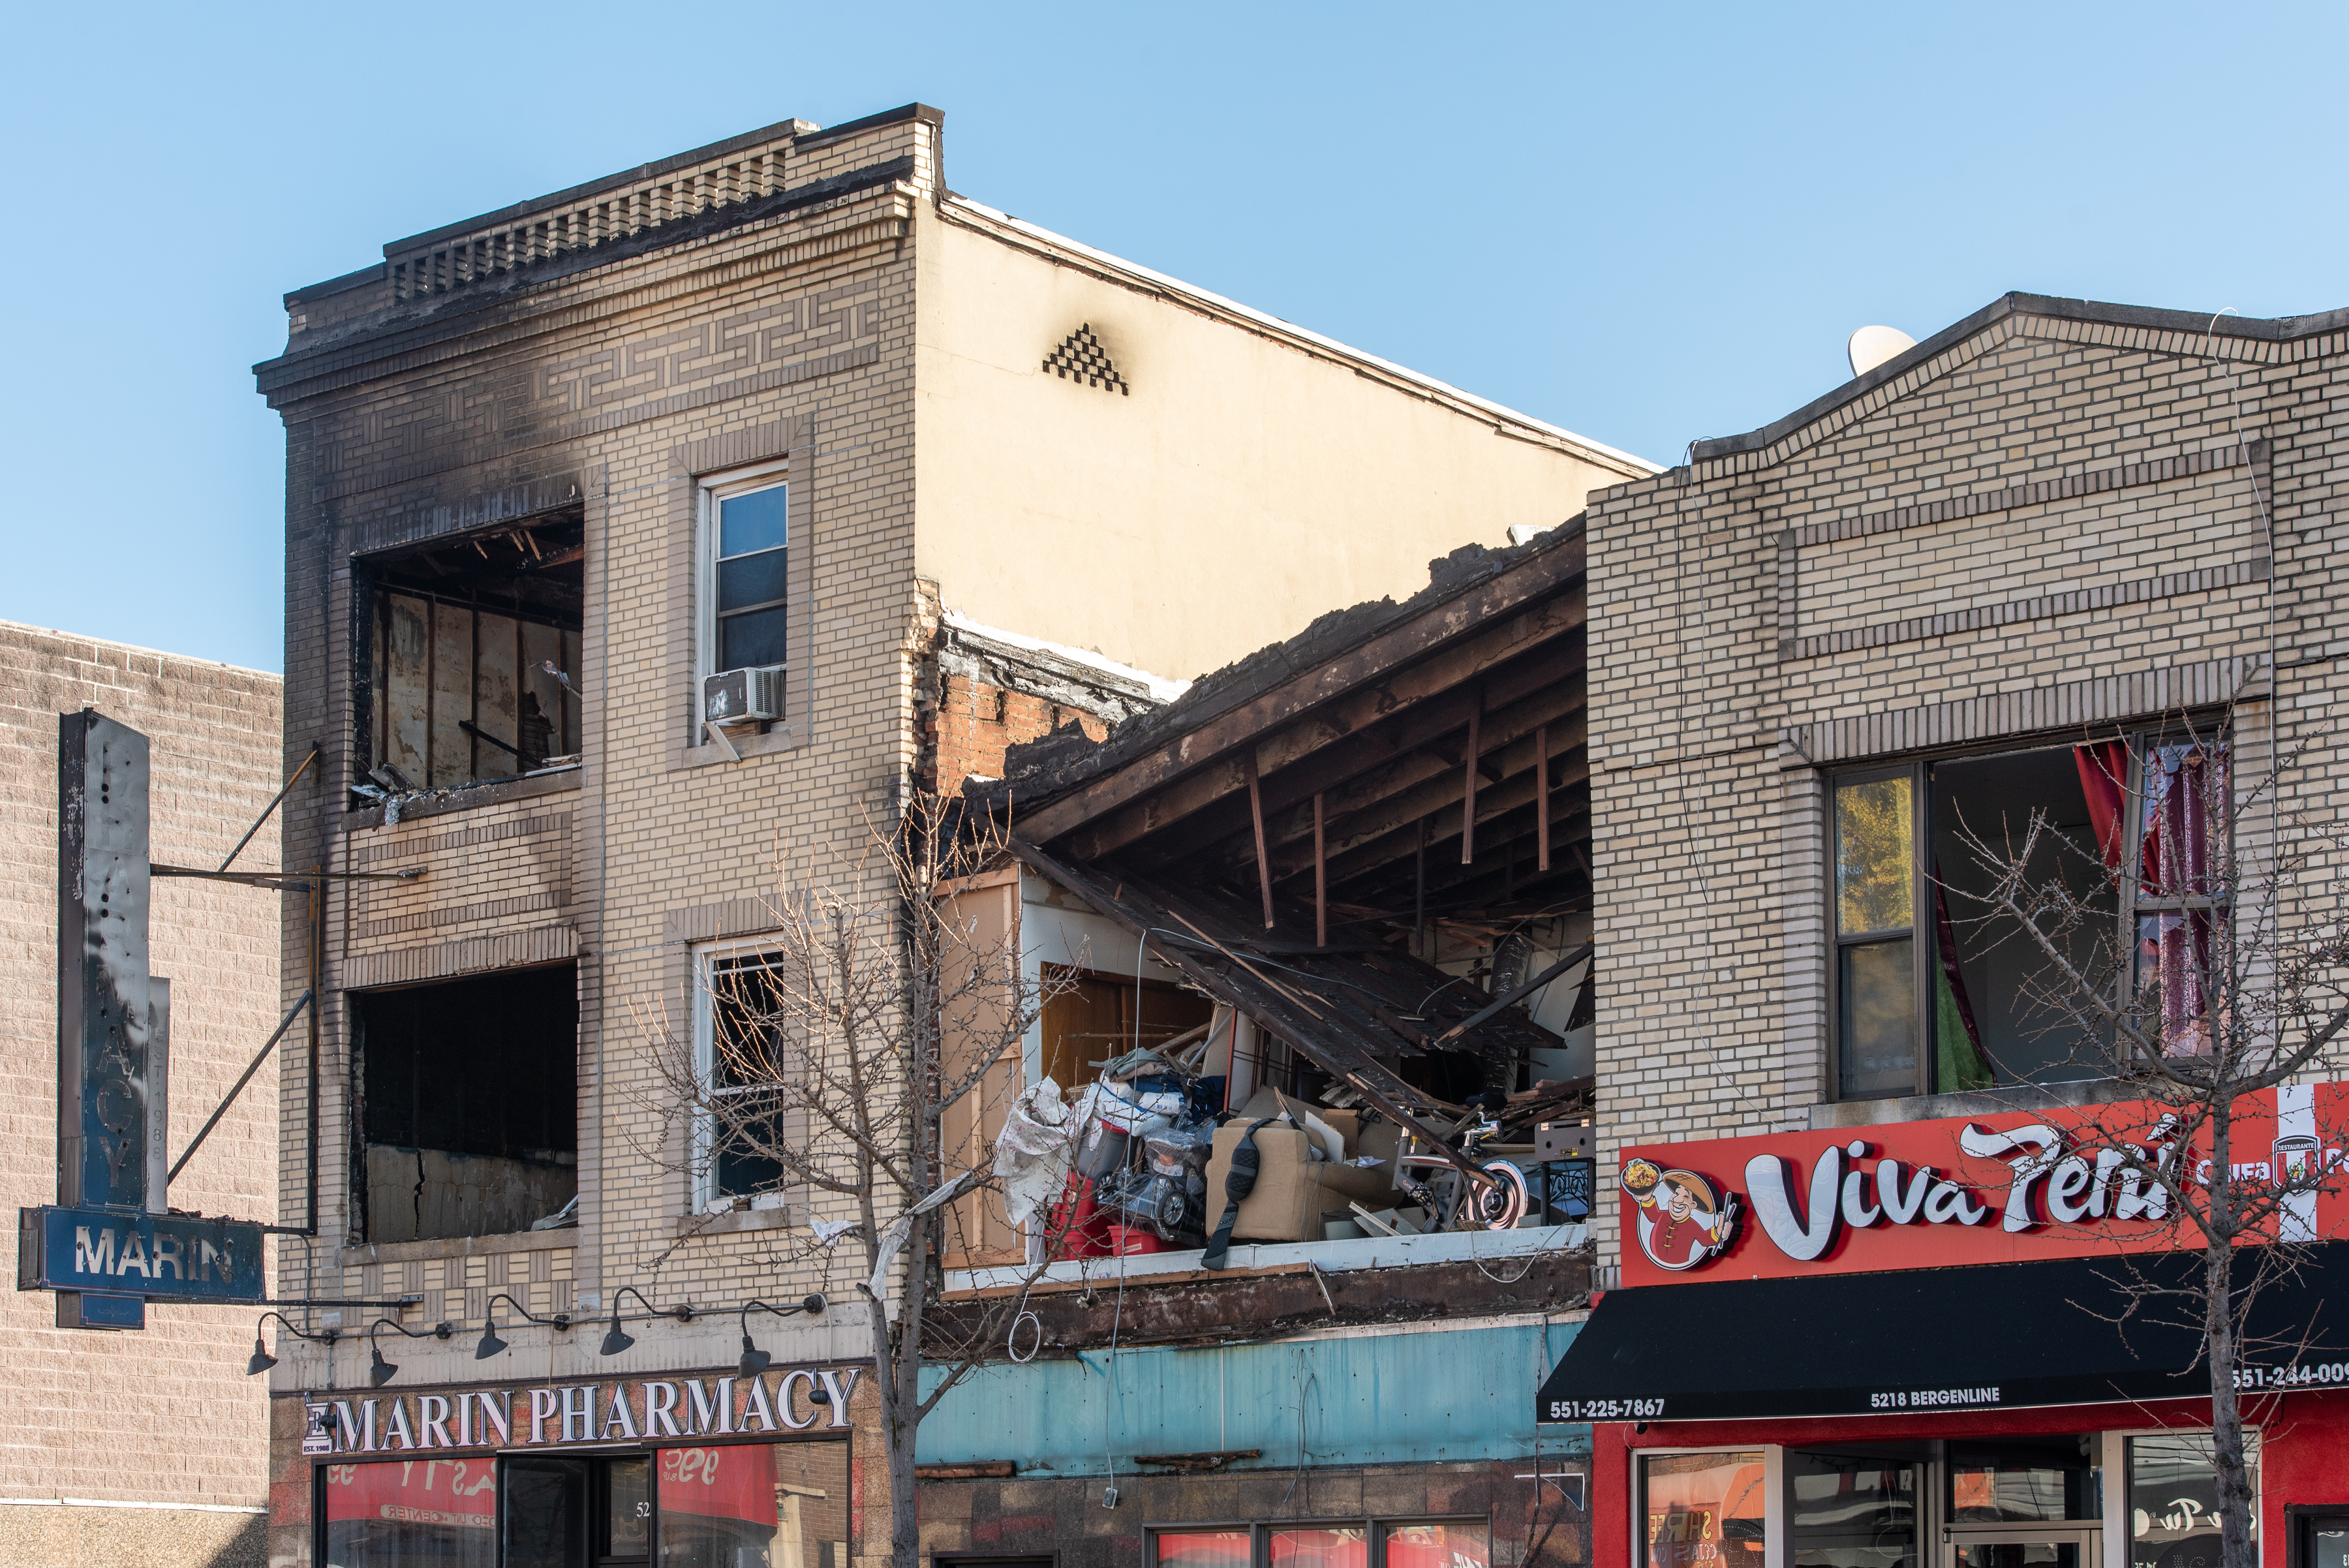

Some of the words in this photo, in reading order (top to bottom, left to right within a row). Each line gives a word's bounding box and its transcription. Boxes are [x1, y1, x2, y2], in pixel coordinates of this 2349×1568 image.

[2277, 1143, 2314, 1151] RESTAURANTE
[1744, 1139, 1986, 1261] Viva
[75, 1225, 232, 1284] MARIN
[331, 1389, 515, 1454] MARIN
[526, 1367, 863, 1445] PHARMACY
[1550, 1398, 1665, 1419] 551-225-7867
[1871, 1392, 1907, 1407] 5218
[1911, 1387, 2000, 1406] BERGENLINE
